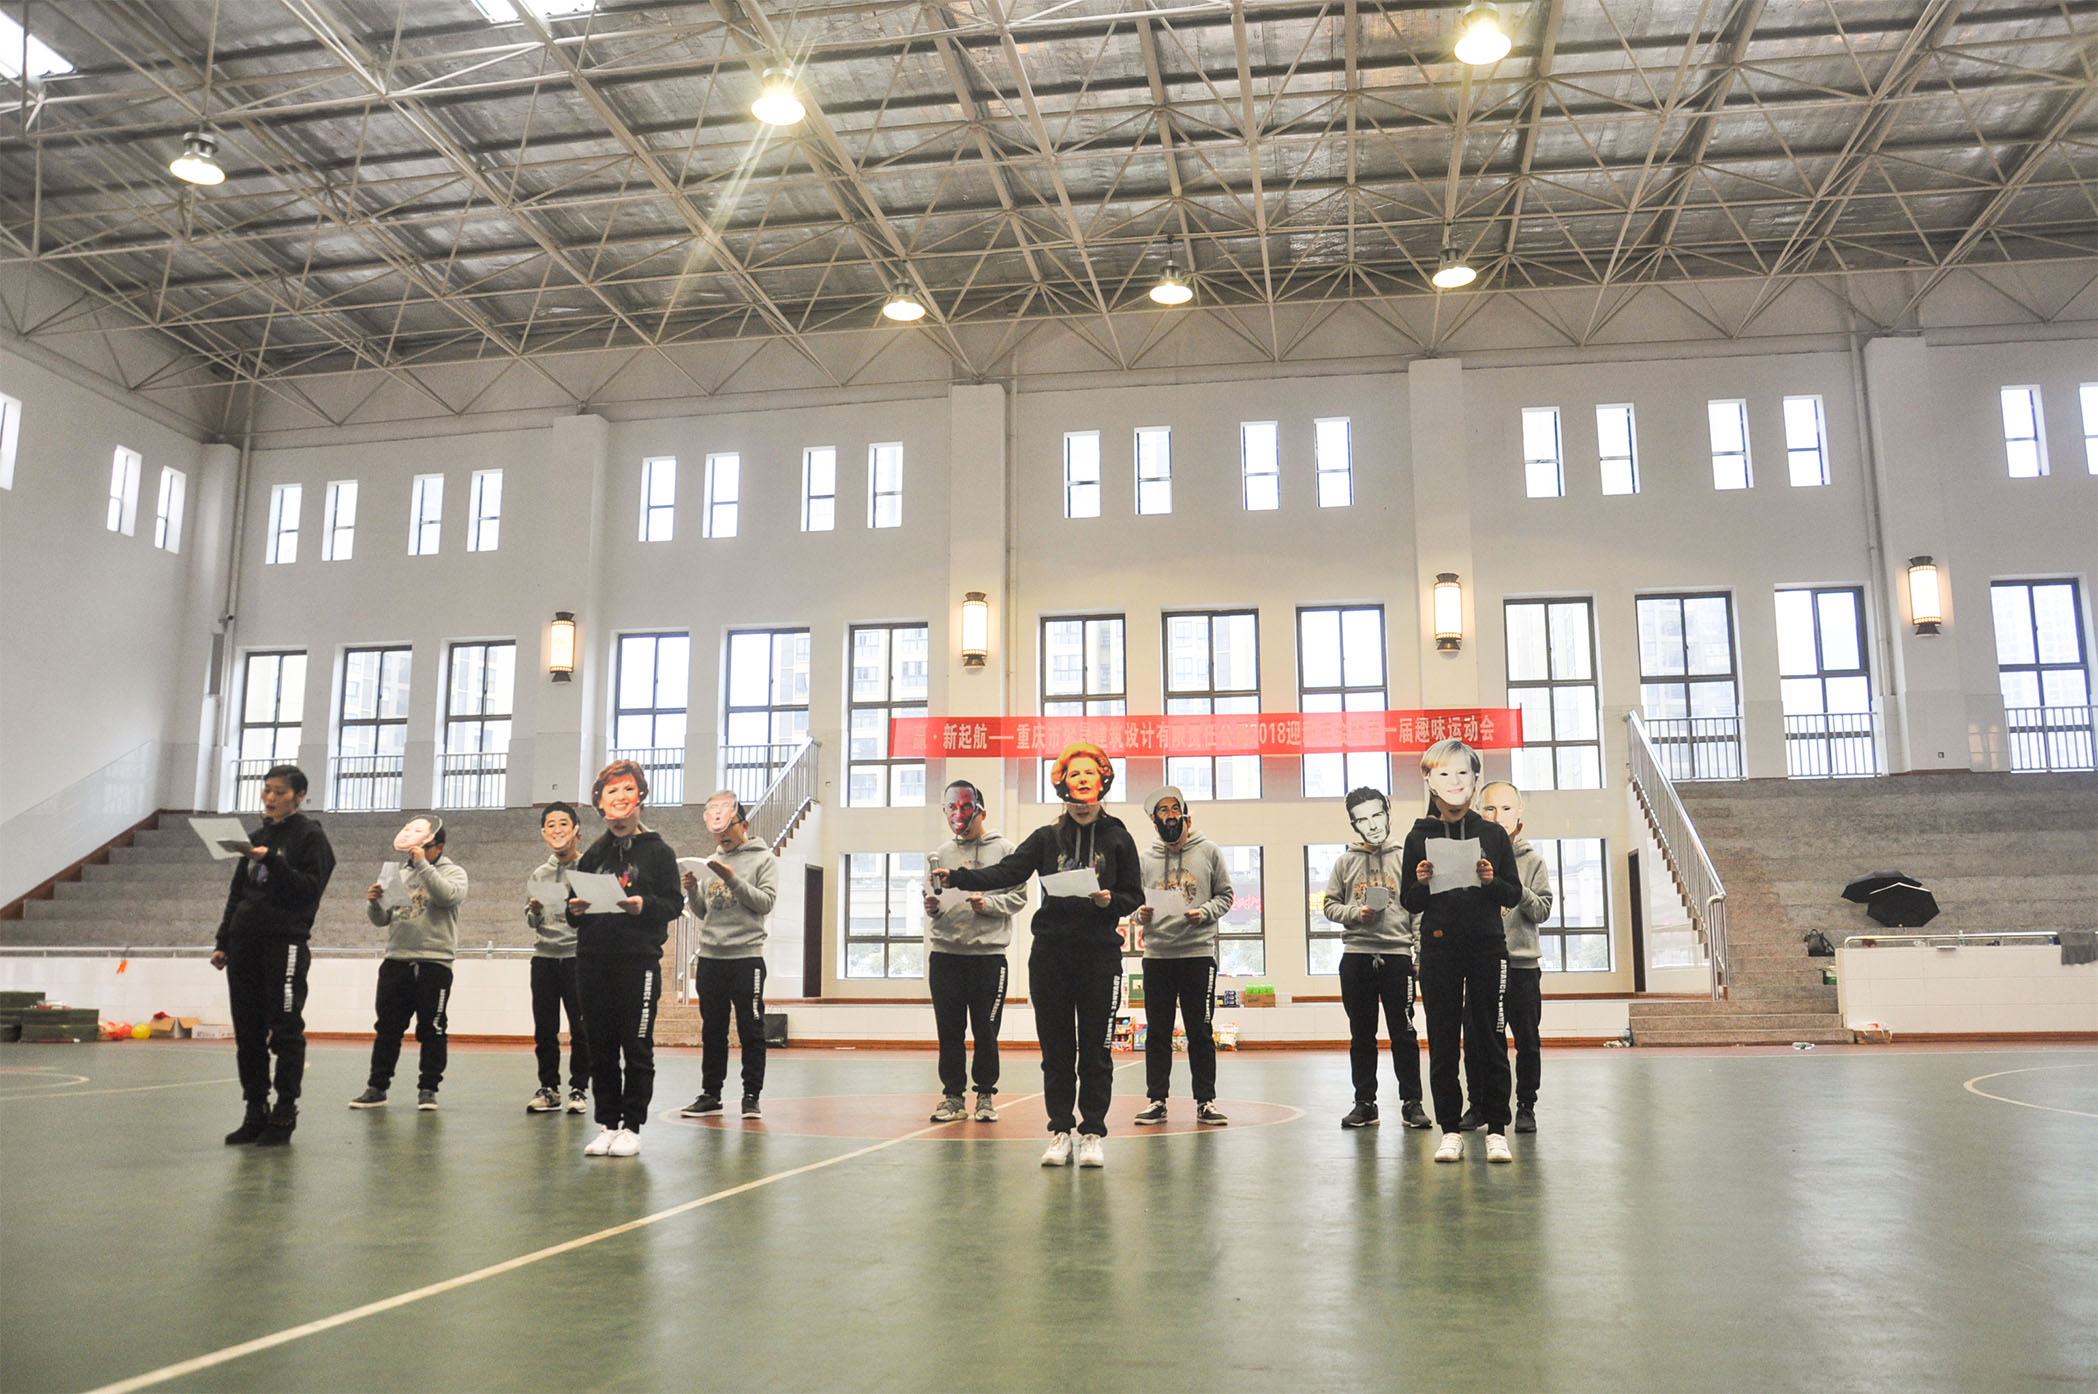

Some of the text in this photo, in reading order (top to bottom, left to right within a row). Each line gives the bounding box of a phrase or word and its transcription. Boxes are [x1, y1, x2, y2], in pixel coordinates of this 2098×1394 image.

[997, 966, 1006, 993] ADVANCE
[1498, 959, 1508, 994] ADVANCE
[638, 1008, 649, 1038] BRAVELY
[1103, 975, 1120, 1049] ADVANCE BRAVELY
